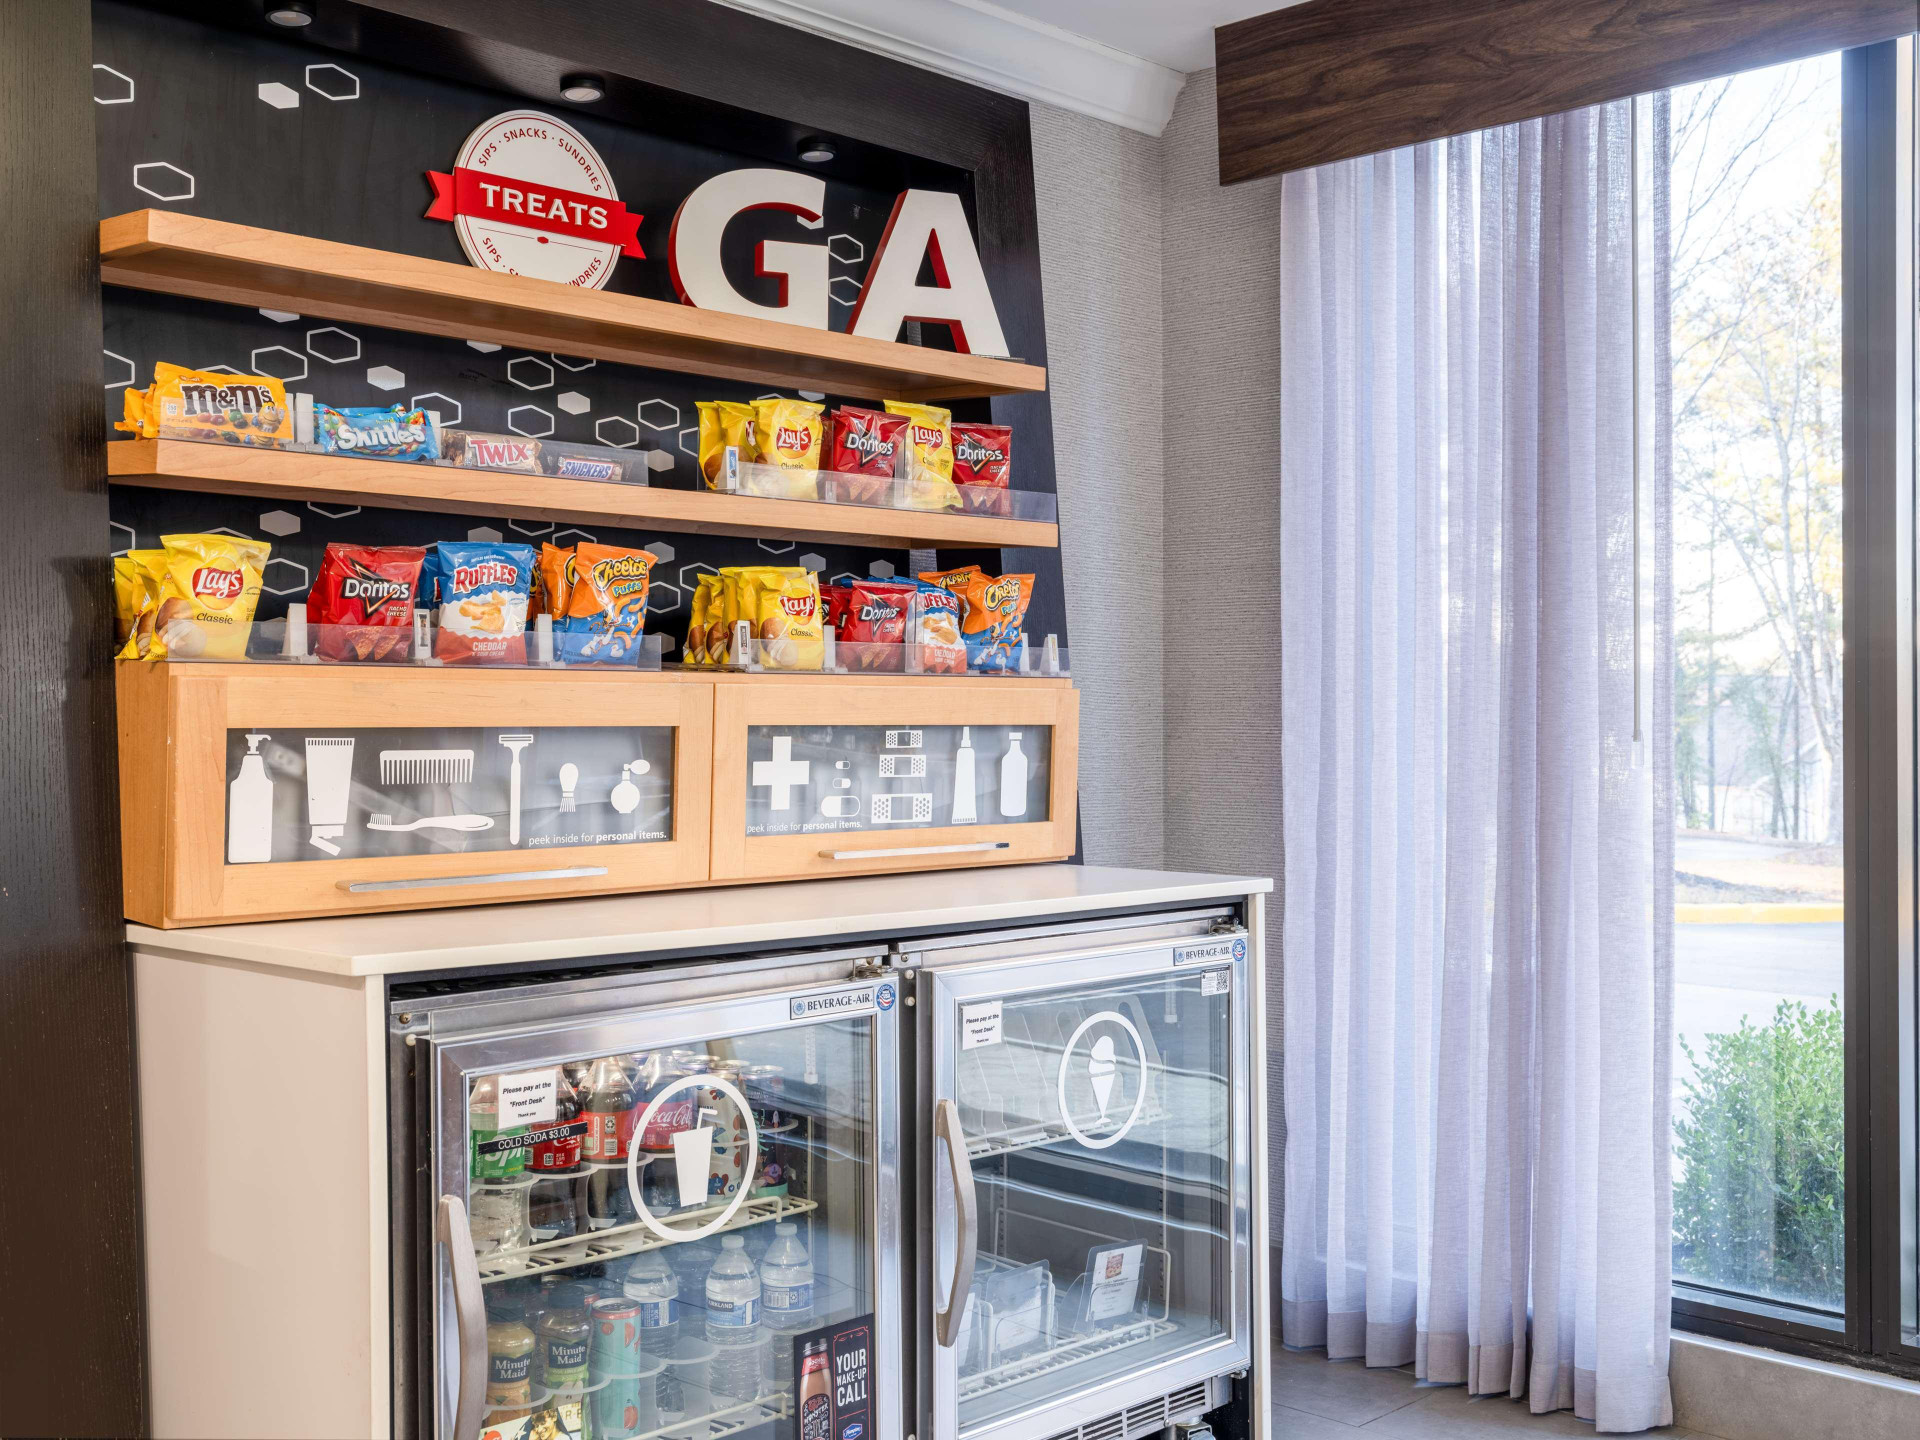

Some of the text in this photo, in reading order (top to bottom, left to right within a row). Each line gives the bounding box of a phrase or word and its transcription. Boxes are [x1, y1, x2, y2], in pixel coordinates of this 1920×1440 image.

[478, 127, 602, 192] SIPS SNACKS SUNDRIES
[479, 182, 608, 229] TREATS
[482, 237, 503, 263] SIPS
[338, 421, 426, 450] Skittles
[778, 426, 809, 451] Lay's
[846, 433, 894, 455] Doritos
[957, 445, 1003, 460] Doritos
[561, 460, 611, 479] SNICKERS
[453, 563, 517, 594] RUFFLES
[592, 556, 649, 591] Cheetos
[195, 568, 241, 599] Lay's
[345, 579, 409, 598] Doritos
[612, 581, 642, 597] Puffs
[196, 612, 234, 625] Classic
[860, 606, 901, 620] Doritos
[473, 642, 508, 651] CHEDDAR
[746, 820, 863, 834] peek inside for personal items.
[528, 830, 667, 847] peek inside for personal items.
[1185, 946, 1230, 960] BEVERAGE-AIR
[807, 993, 871, 1011] BEVERAGE-AIR
[502, 1086, 523, 1094] Please
[509, 1097, 546, 1108] "Front Desk"
[498, 1139, 522, 1150] COLD
[524, 1132, 548, 1145] SODA
[548, 1127, 570, 1139] $3.00
[552, 1345, 586, 1356] Minute
[495, 1358, 531, 1369] Minute
[557, 1355, 582, 1365] Maid
[836, 1348, 866, 1373] YOUR
[500, 1368, 526, 1379] Maid
[837, 1367, 867, 1386] WAKE-UP
[837, 1380, 867, 1407] CALL
